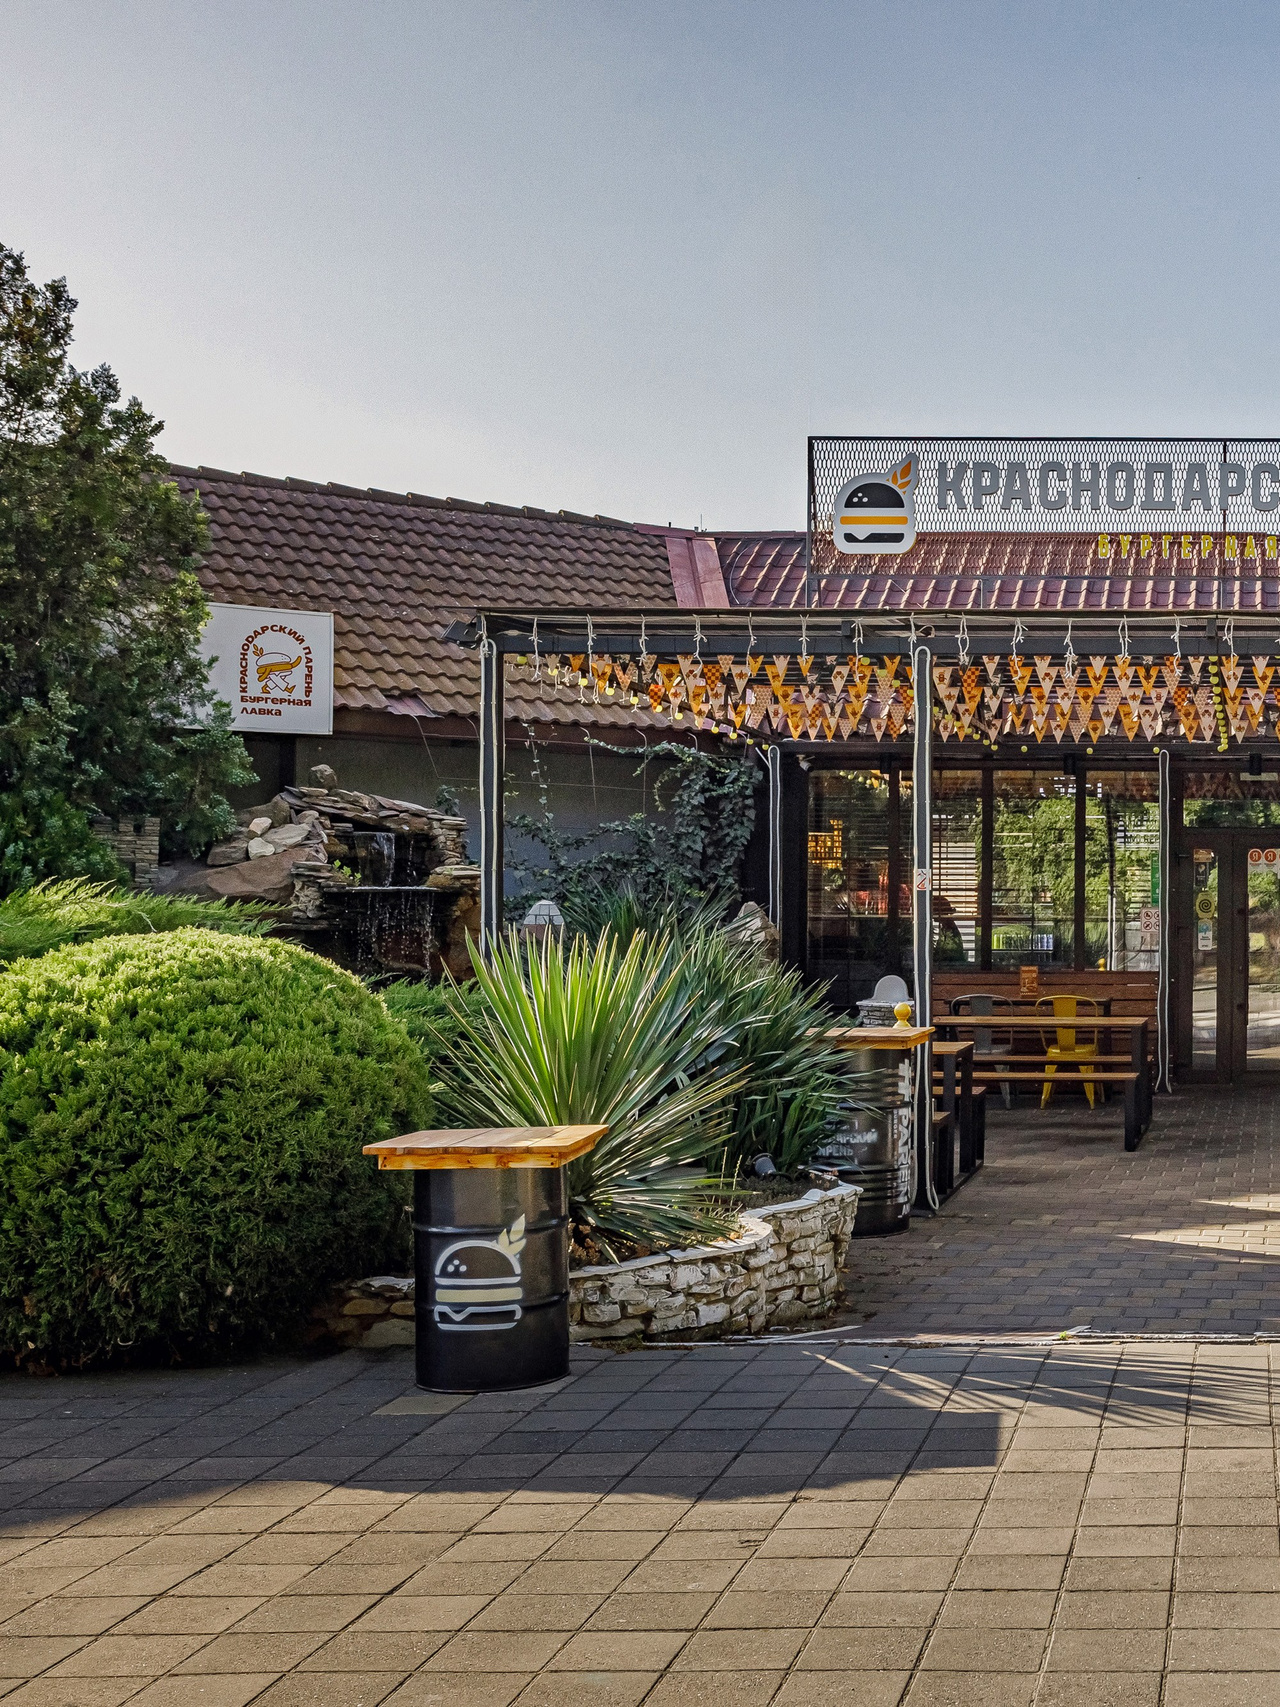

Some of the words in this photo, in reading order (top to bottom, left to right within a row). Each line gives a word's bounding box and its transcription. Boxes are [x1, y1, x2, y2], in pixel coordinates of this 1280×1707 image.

[1098, 534, 1278, 559] БУРГЕРНАЯ
[239, 624, 306, 694] КРАСНОДАРСКИЙ
[302, 646, 313, 698] ПАРЕНЬ
